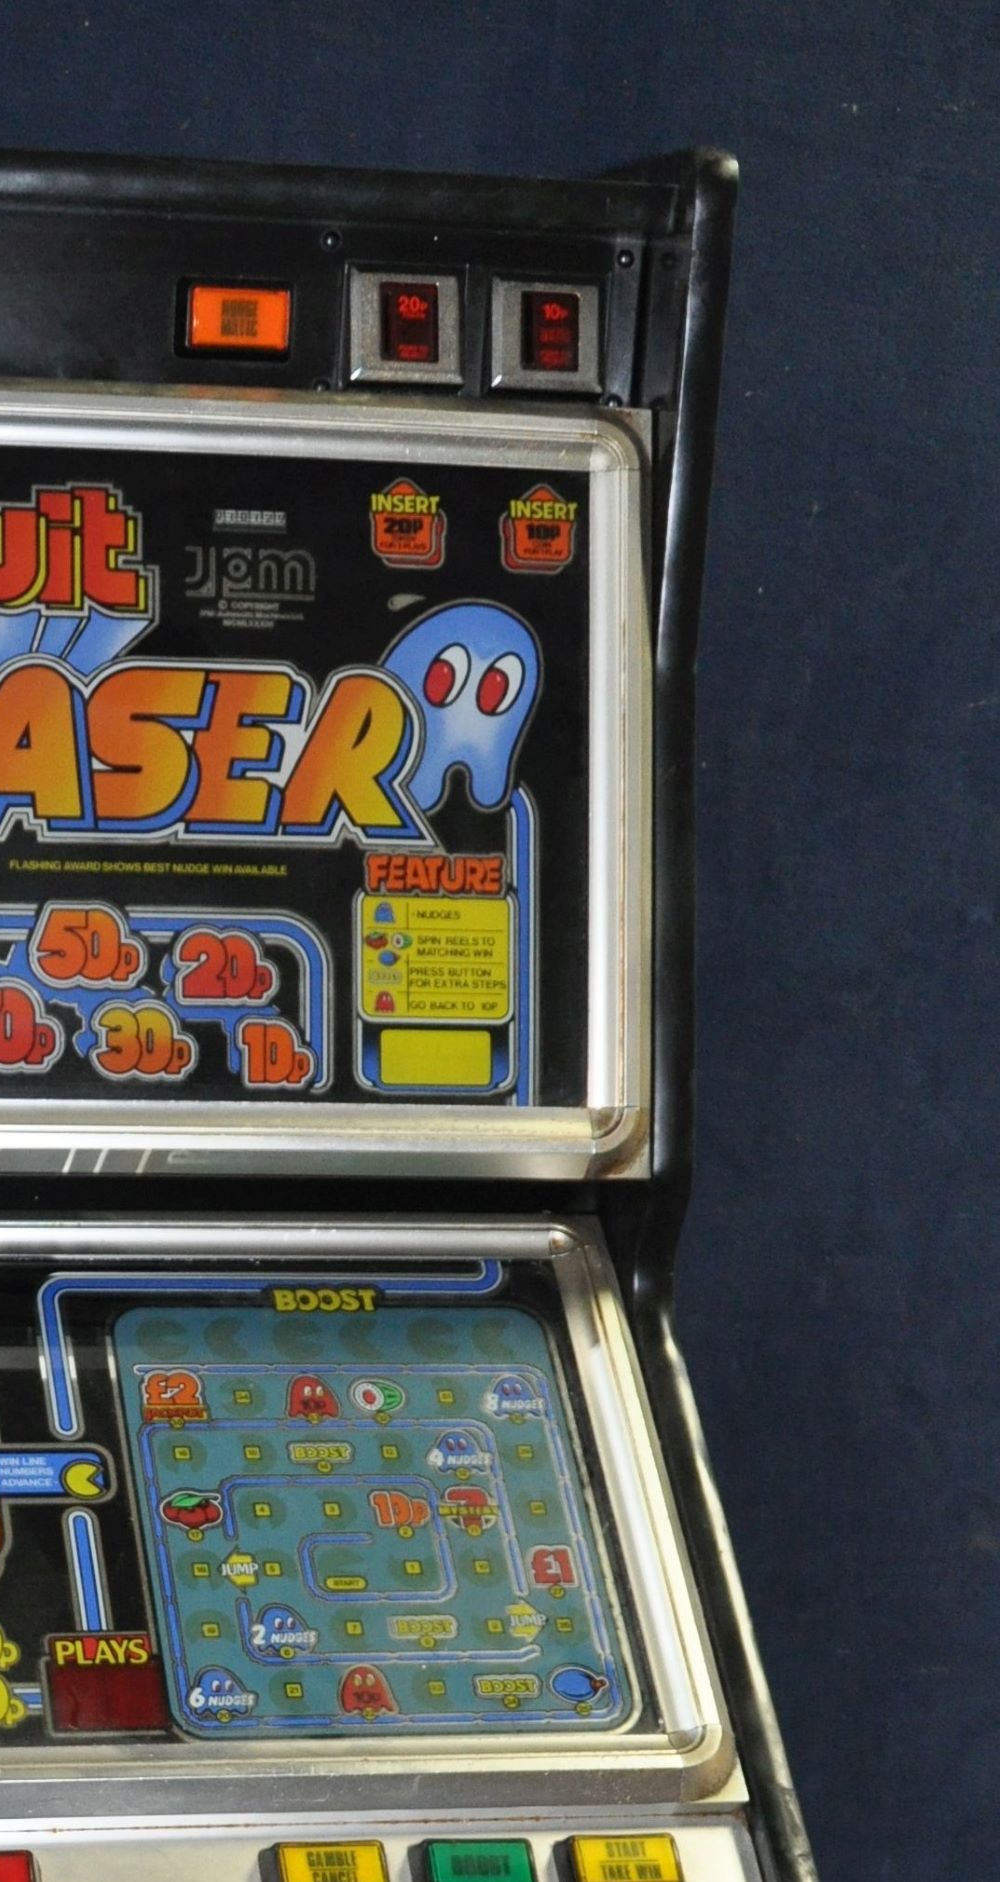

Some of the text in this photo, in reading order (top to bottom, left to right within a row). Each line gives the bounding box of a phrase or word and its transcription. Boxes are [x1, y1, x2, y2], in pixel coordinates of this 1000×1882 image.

[370, 492, 440, 514] INSERT
[509, 499, 578, 521] INSERT
[9, 860, 288, 876] FLASHING AWARD SHOWS BEST NUDGE WIN AVAILABLE
[367, 854, 503, 894] FEATURE
[416, 910, 461, 920] NUDGES
[417, 936, 495, 946] SPIN REELS TO
[417, 948, 493, 958] MATCHING WIN
[410, 967, 445, 977] PRESS
[448, 967, 492, 977] BUTTON
[410, 979, 507, 989] FOR EXTRA STEPS
[410, 1002, 426, 1010] GO
[430, 1002, 458, 1010] BACK
[462, 1002, 475, 1010] TO
[273, 1288, 377, 1312] BOOST
[146, 1372, 199, 1406] £2
[502, 1399, 544, 1410] NUDGES
[293, 1446, 348, 1459] BOOST
[429, 1448, 492, 1467] 4 NUDGES
[22, 1456, 46, 1466] LINE
[0, 1466, 54, 1477] NUMBERS
[1, 1477, 53, 1488] ADVANCE
[221, 1562, 259, 1576] JUMP
[531, 1548, 576, 1584] £1
[396, 1619, 453, 1633] BOOST
[510, 1614, 547, 1627] JUMP
[251, 1623, 318, 1645] 2 NUDGES
[55, 1638, 149, 1665] PLAYS
[479, 1679, 536, 1693] BOOST
[189, 1687, 256, 1707] 6 NUDGES
[605, 1841, 647, 1857] START
[306, 1850, 358, 1868] GAMBLE
[600, 1863, 663, 1881] TAKE WIN
